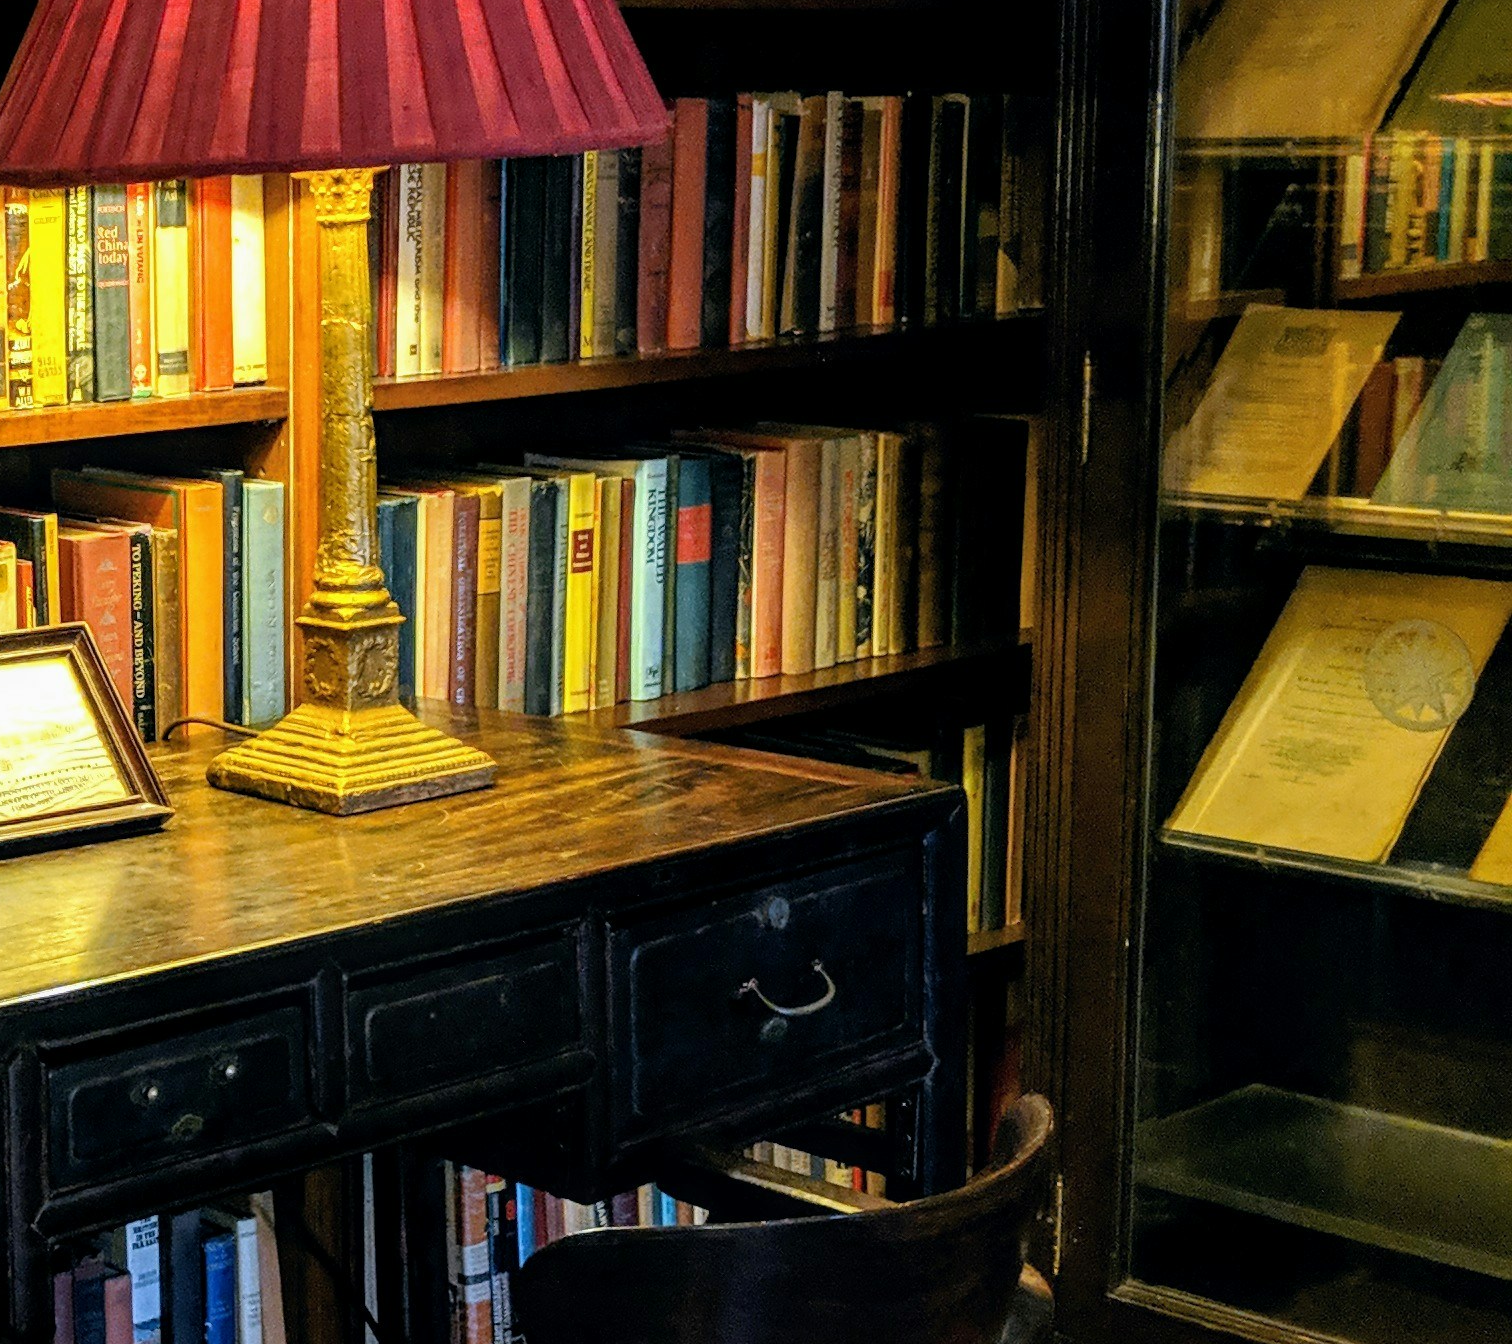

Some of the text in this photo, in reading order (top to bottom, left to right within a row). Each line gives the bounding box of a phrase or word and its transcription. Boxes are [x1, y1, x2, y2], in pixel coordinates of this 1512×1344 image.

[97, 226, 118, 239] Red
[97, 240, 128, 252] China
[646, 488, 656, 564] KINGDOM
[132, 542, 145, 699] TO PEKING AND BEYOND
